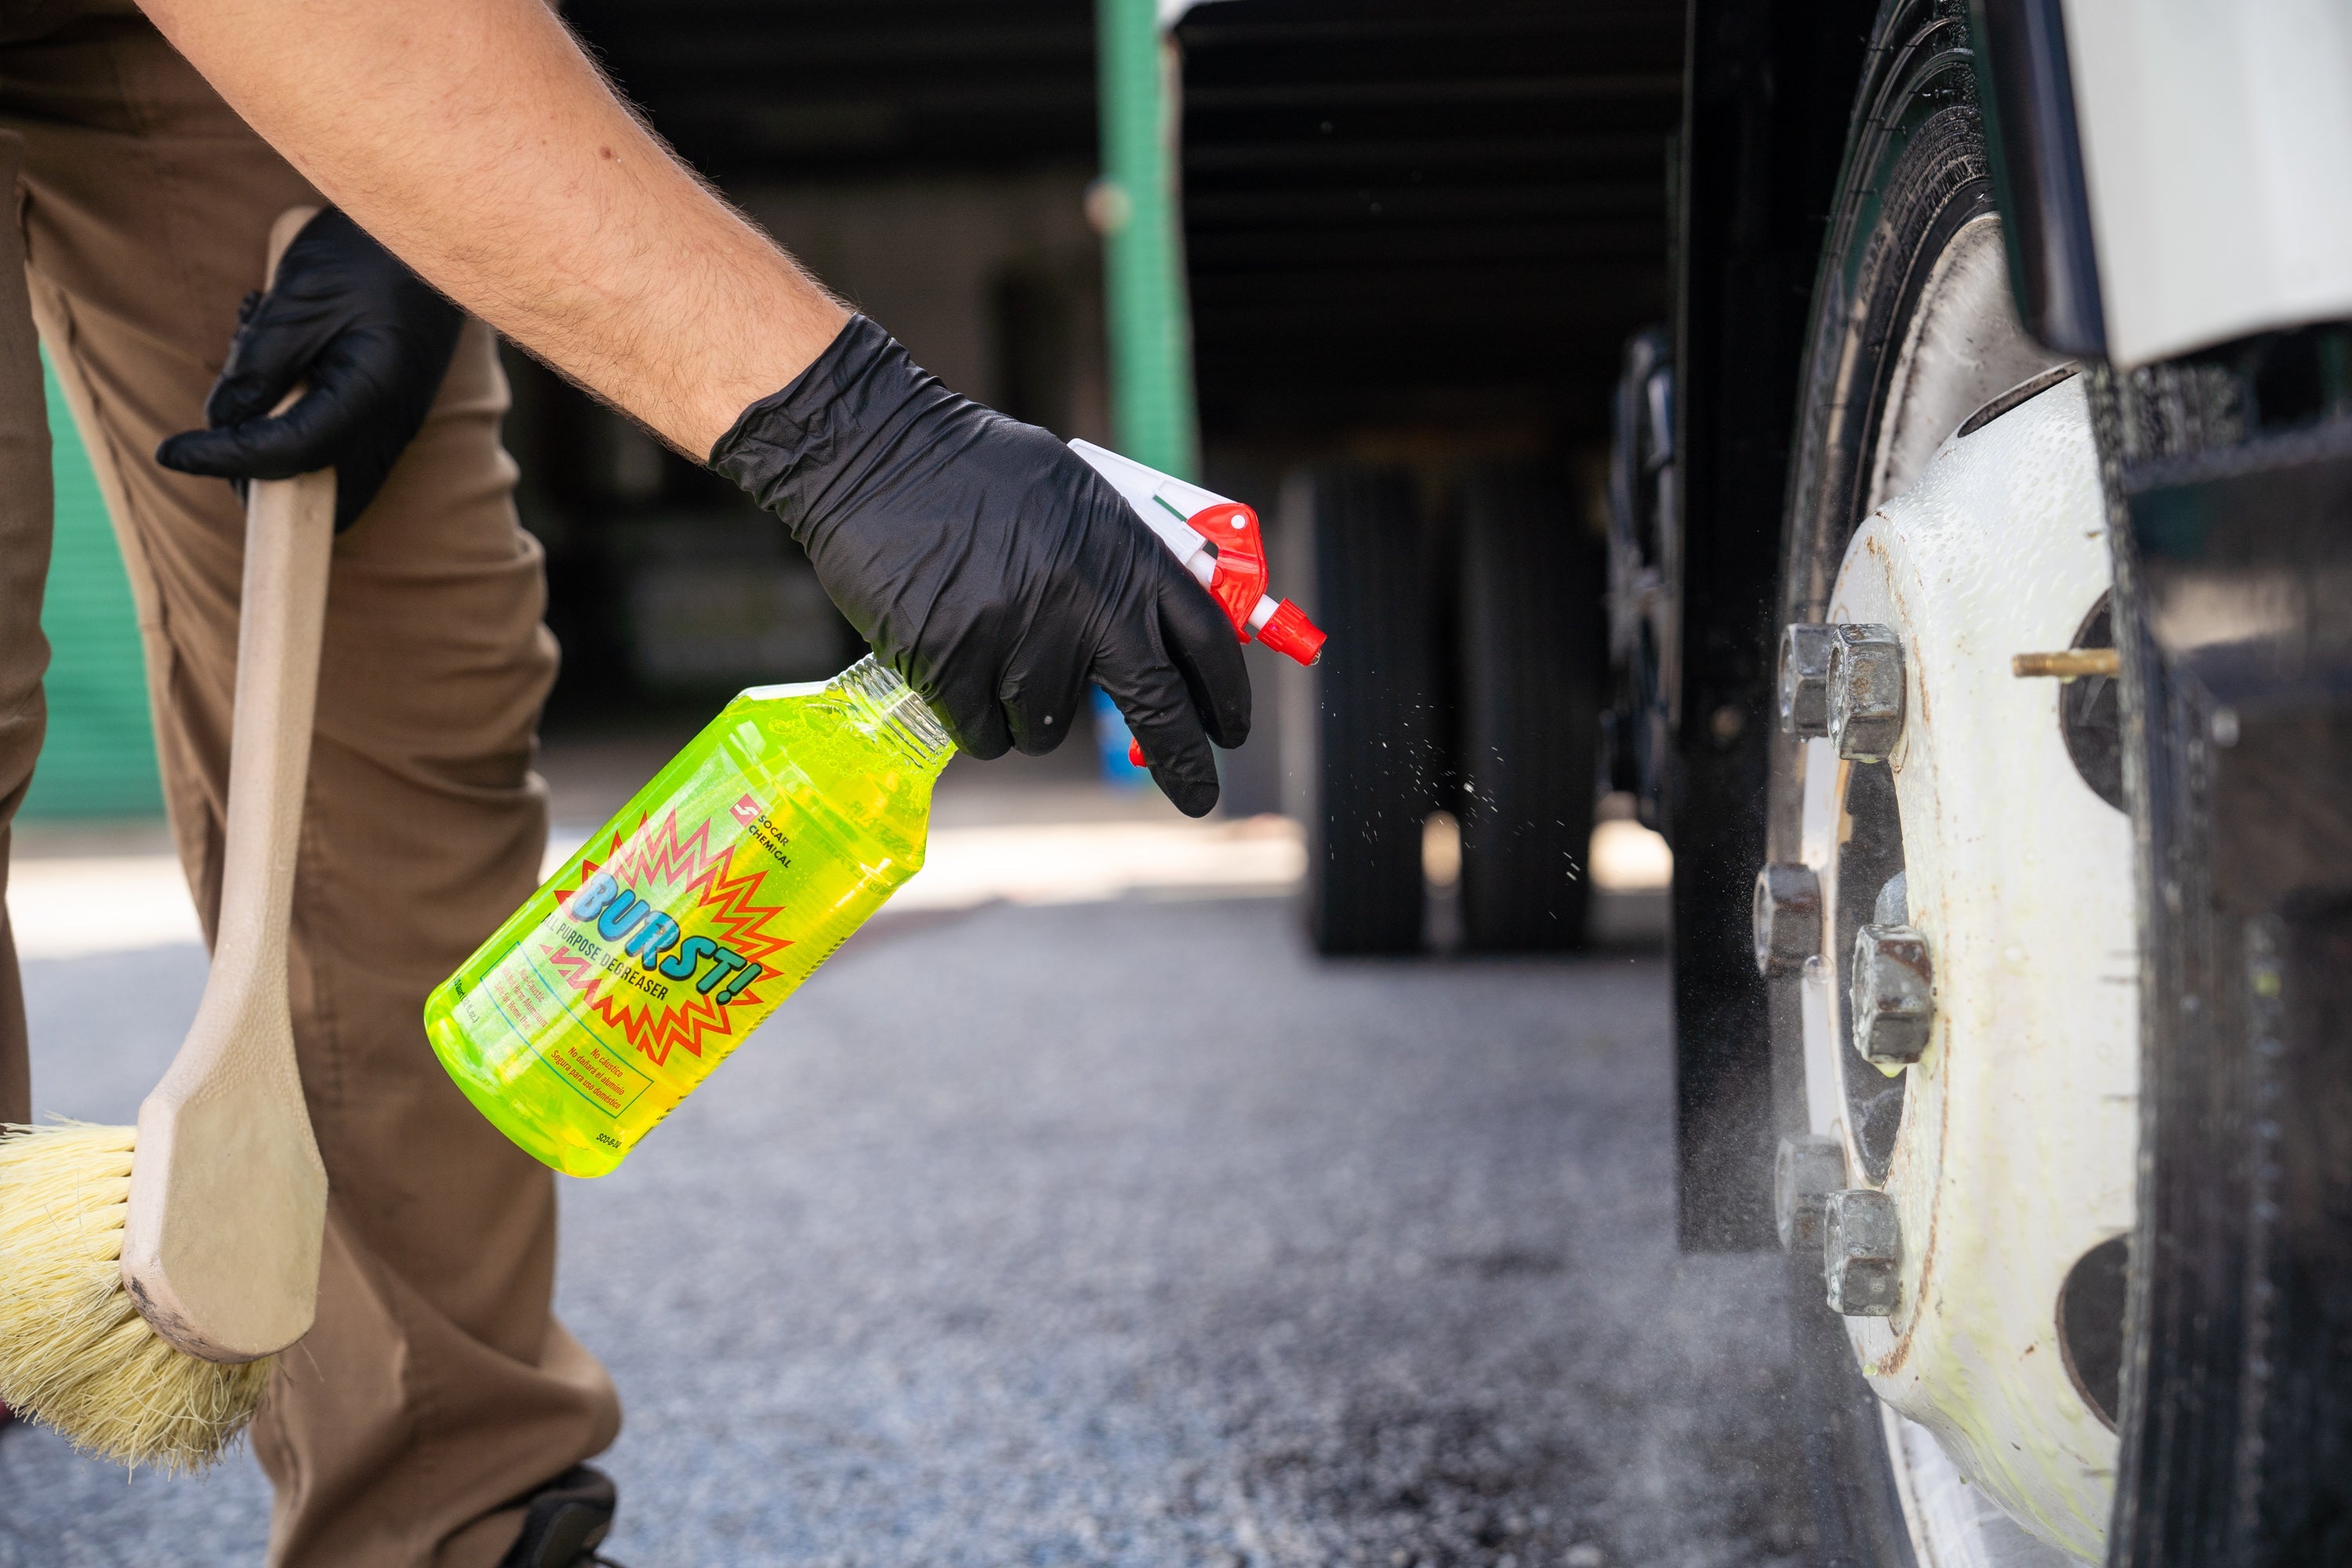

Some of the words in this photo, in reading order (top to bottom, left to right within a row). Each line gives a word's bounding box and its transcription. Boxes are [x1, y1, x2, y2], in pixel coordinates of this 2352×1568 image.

[749, 825, 792, 868] CHEMICAL
[758, 815, 789, 847] SOCAR
[540, 913, 554, 931] ALL
[556, 923, 601, 961] PURPOSE
[600, 949, 669, 1001] DEGREASER
[572, 872, 763, 1005] BURST!
[513, 983, 526, 1001] Harm
[523, 997, 548, 1028] Aluminum
[519, 967, 545, 1003] Non-Caustic
[502, 992, 510, 1004] for
[507, 1000, 522, 1018] Home
[520, 1015, 531, 1029] Use
[551, 1050, 572, 1072] Segura
[568, 1069, 585, 1083] para
[583, 1080, 595, 1091] uso
[593, 1087, 621, 1109] doméstico
[568, 1047, 578, 1058] No
[576, 1055, 599, 1075] dañará
[601, 1077, 625, 1096] aluminio
[590, 1048, 601, 1059] No
[599, 1057, 623, 1078] cáustico
